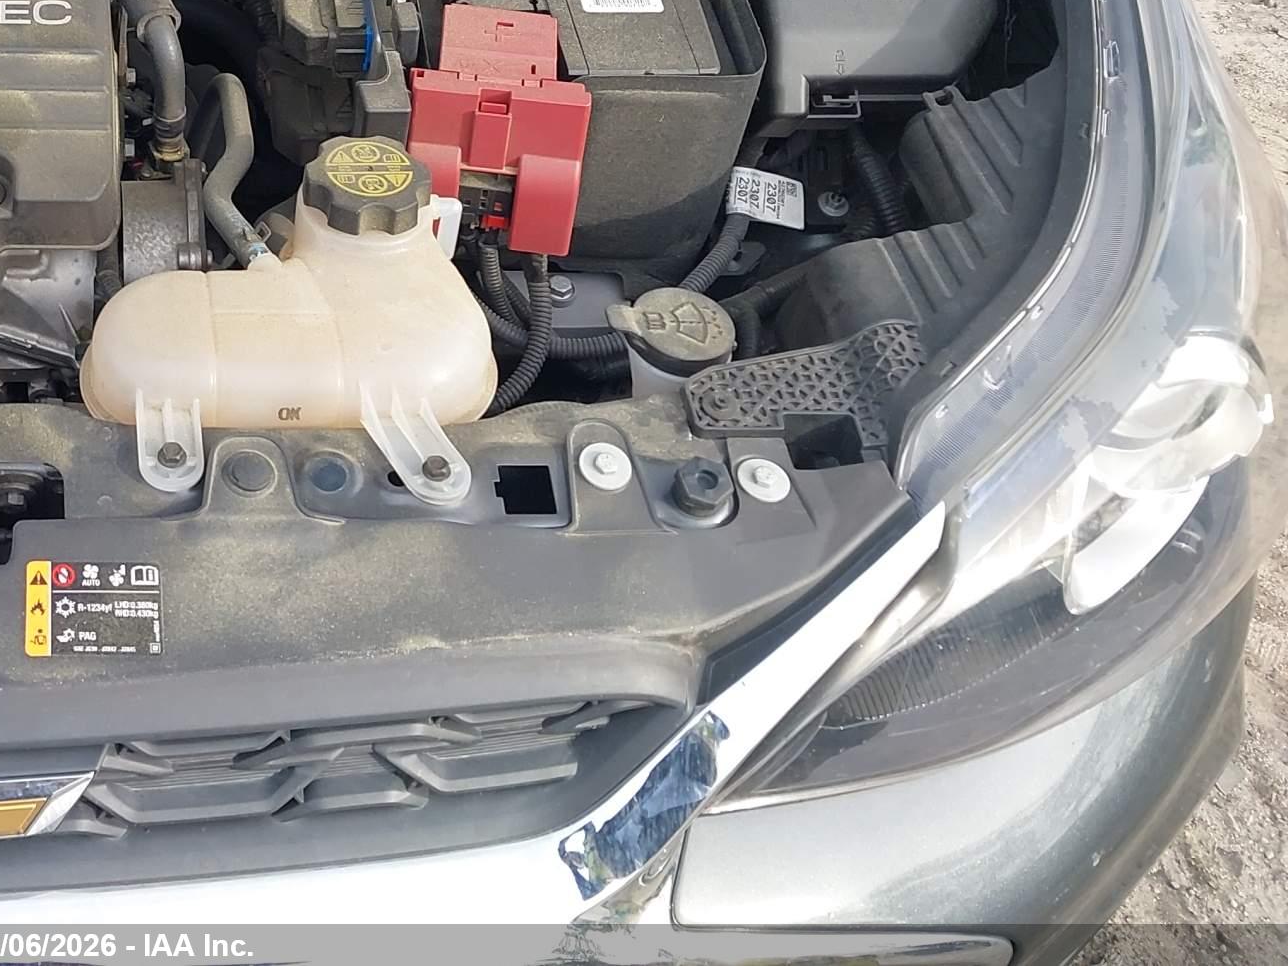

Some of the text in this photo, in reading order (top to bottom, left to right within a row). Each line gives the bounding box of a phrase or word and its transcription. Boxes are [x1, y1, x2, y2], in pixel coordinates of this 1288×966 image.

[737, 176, 750, 204] 2307
[749, 179, 761, 209] 2307
[766, 182, 778, 213] 2307
[81, 579, 101, 587] AUTO
[78, 631, 97, 641] PAG
